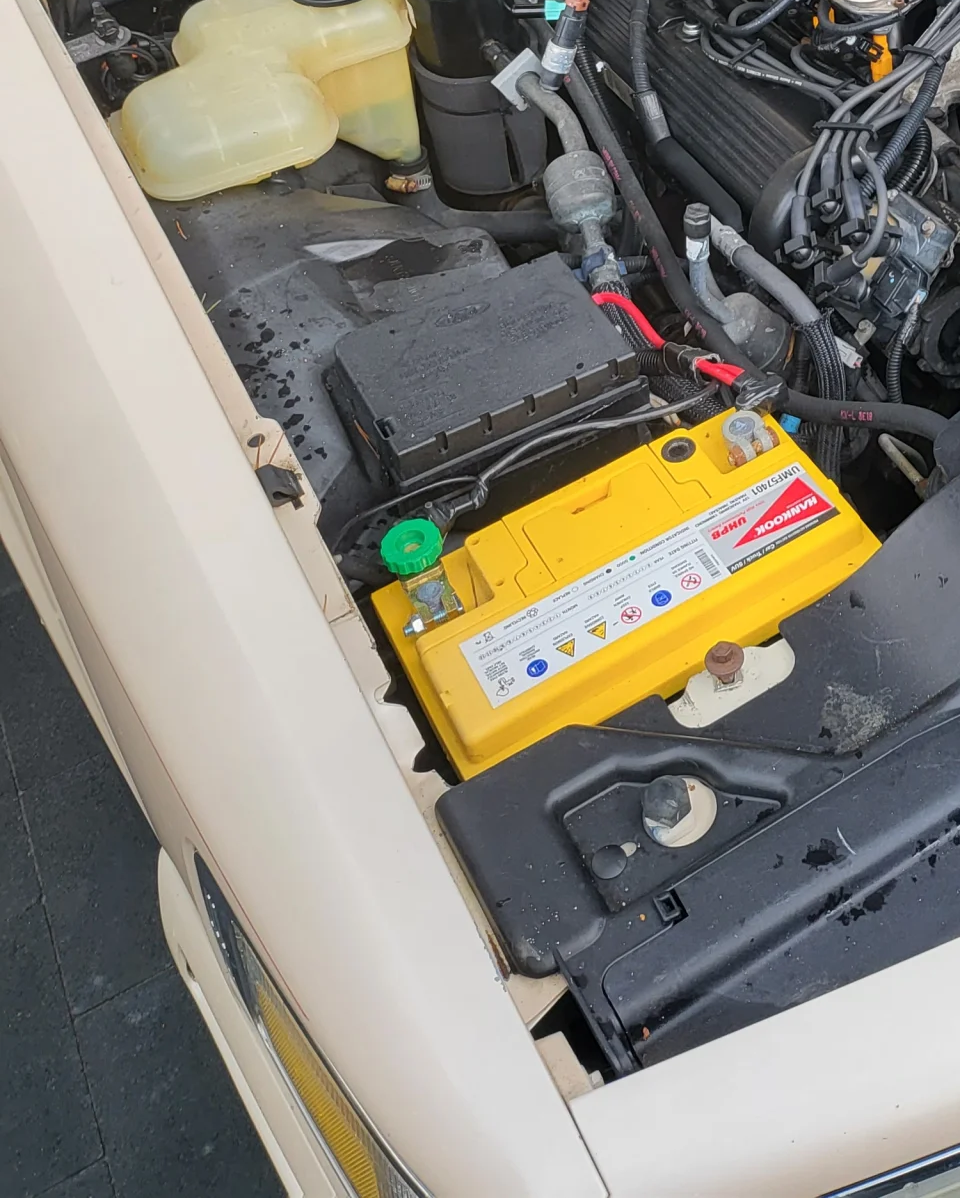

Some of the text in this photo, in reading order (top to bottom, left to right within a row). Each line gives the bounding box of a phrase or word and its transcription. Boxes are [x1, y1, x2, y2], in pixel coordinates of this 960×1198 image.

[750, 465, 800, 495] UMF57401
[753, 495, 819, 535] HANKOOK
[709, 515, 748, 540] UHPB
[764, 543, 775, 551] Car
[745, 551, 762, 562] Truck
[729, 561, 744, 571] SUV
